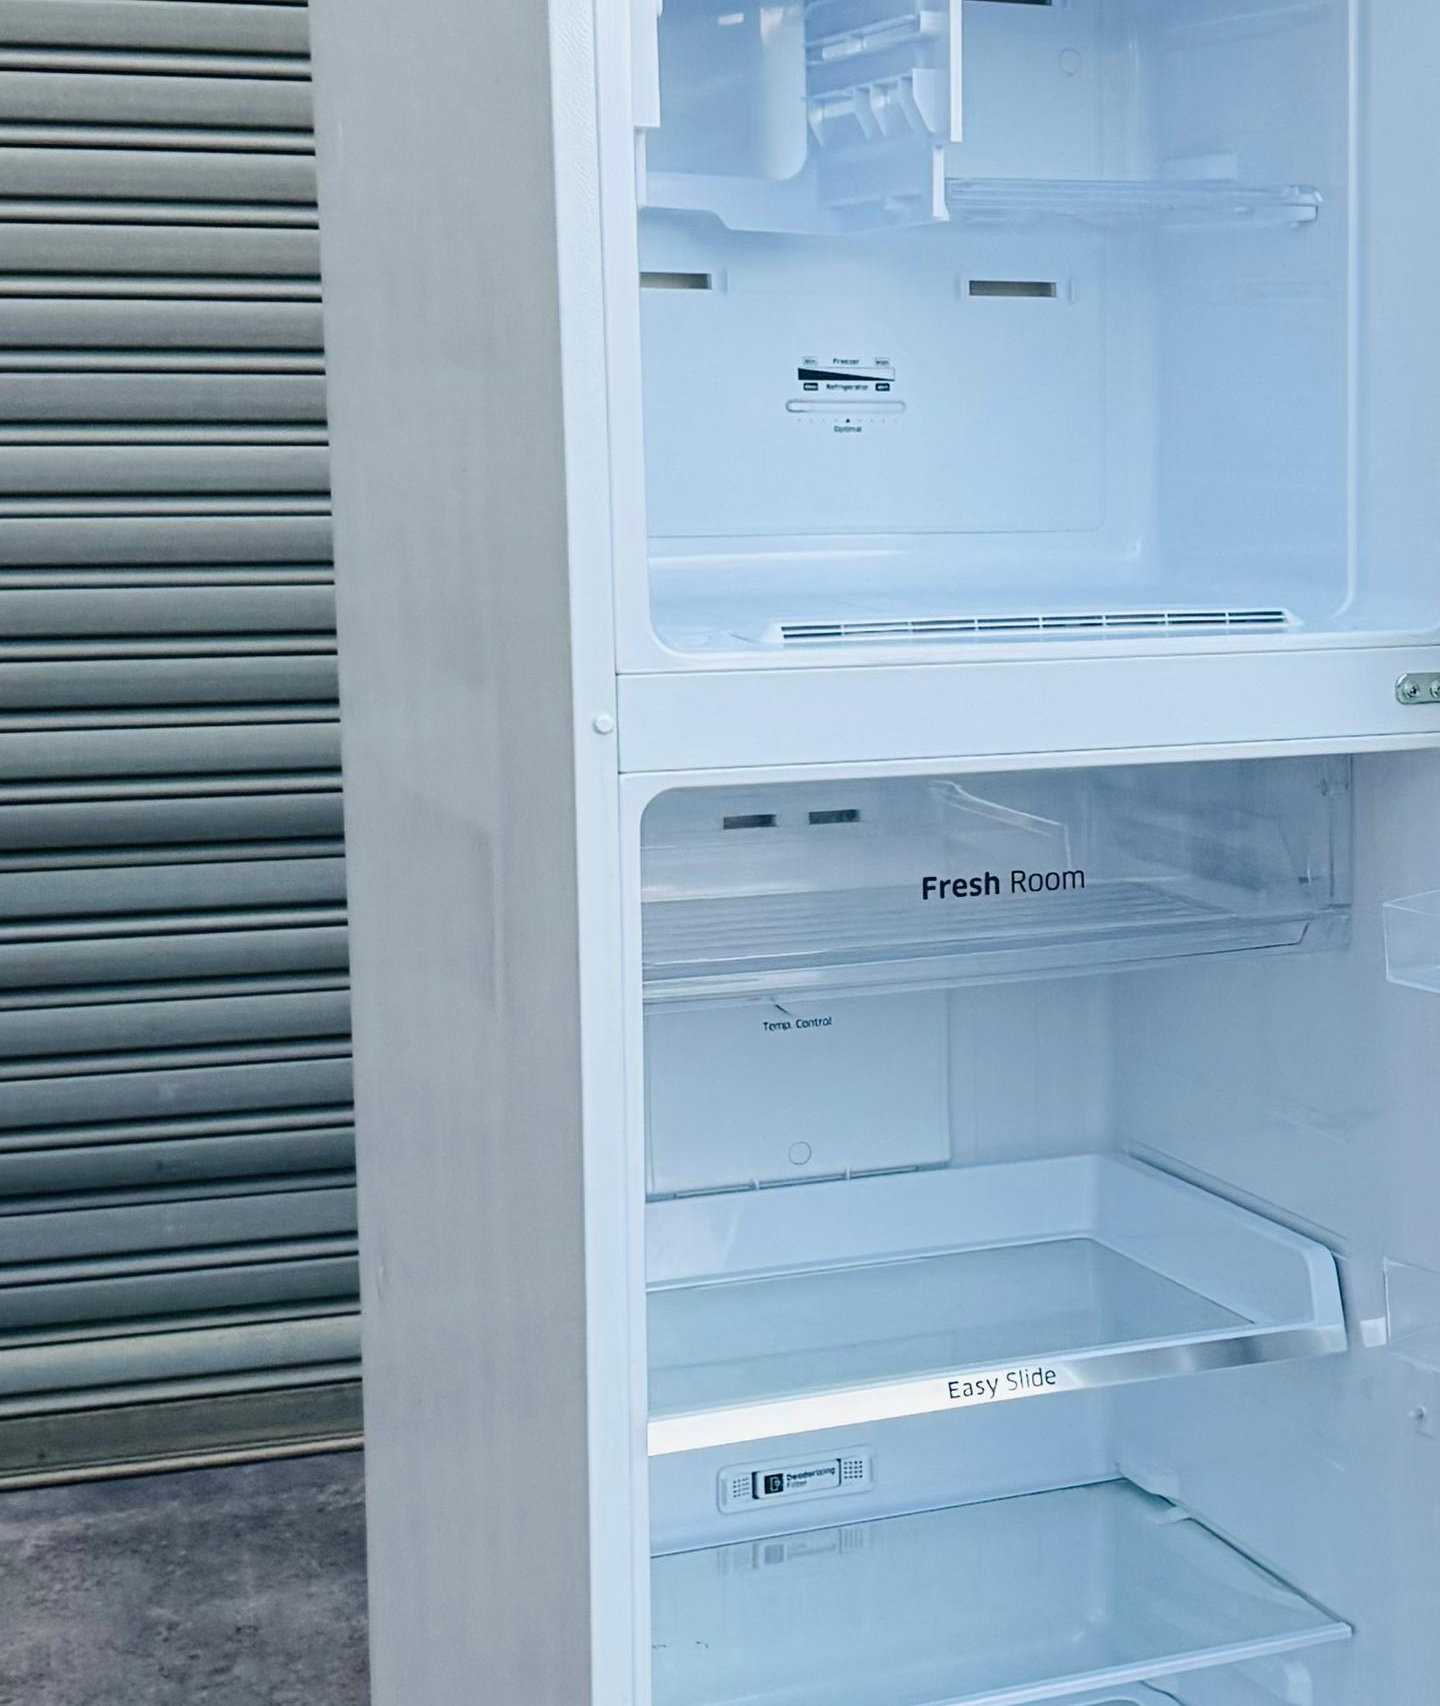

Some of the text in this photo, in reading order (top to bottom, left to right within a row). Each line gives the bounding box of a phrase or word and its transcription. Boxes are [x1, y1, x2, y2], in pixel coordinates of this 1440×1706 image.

[922, 869, 1085, 900] Fresh Room
[795, 1016, 832, 1029] Control
[948, 1367, 1056, 1399] Easy Slide
